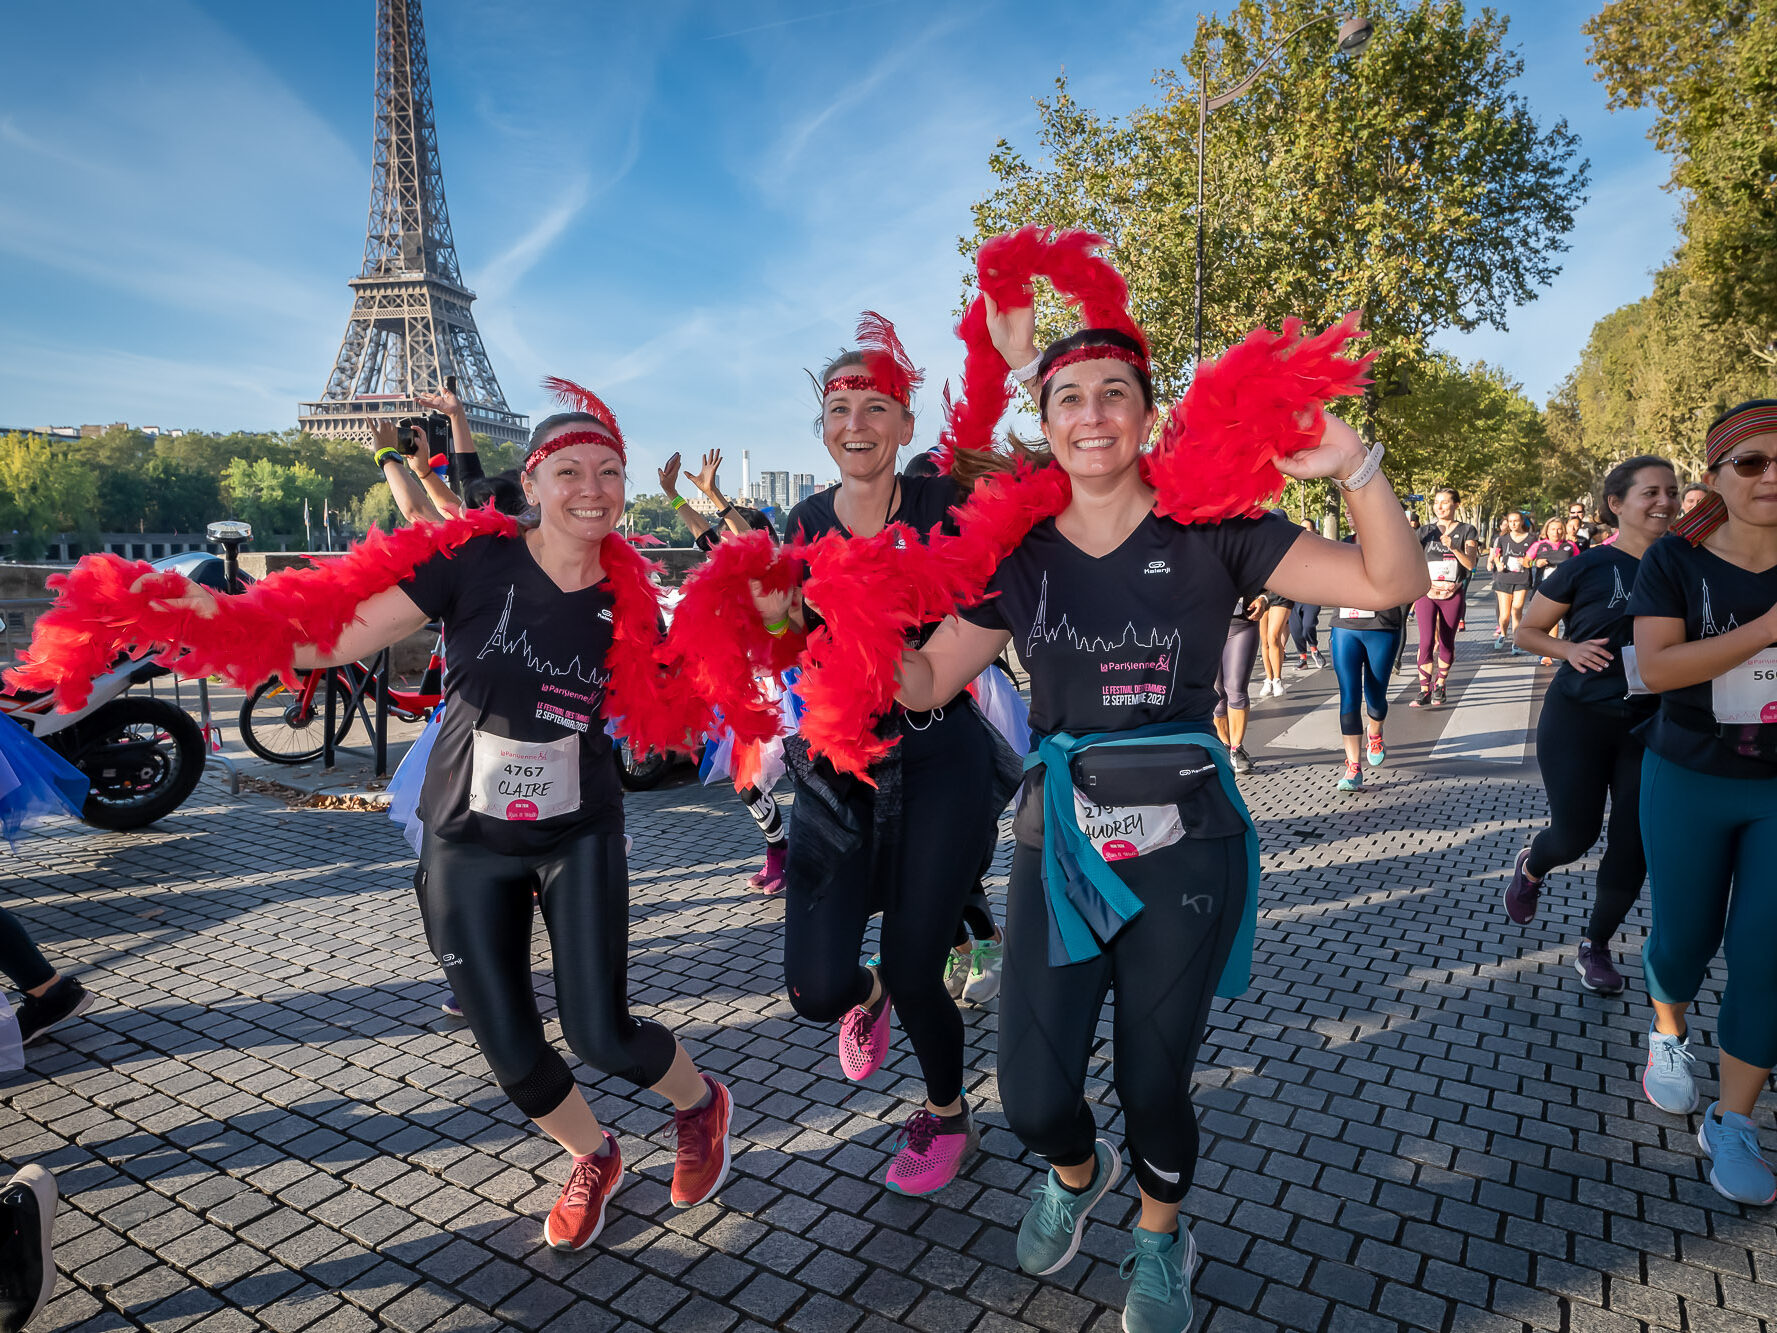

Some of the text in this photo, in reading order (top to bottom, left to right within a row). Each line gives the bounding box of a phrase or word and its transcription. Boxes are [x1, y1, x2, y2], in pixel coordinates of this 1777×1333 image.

[1753, 670, 1777, 681] 56
[1102, 685, 1109, 695] LE
[1109, 685, 1133, 695] FESTIVAL
[537, 701, 544, 710] LE
[1103, 695, 1110, 706] 12
[1146, 692, 1165, 706] 2021
[535, 709, 543, 719] 12
[504, 764, 544, 777] 4767
[498, 780, 554, 798] CLAIRE
[1084, 804, 1125, 818] 279
[1085, 813, 1145, 841] AUDREY
